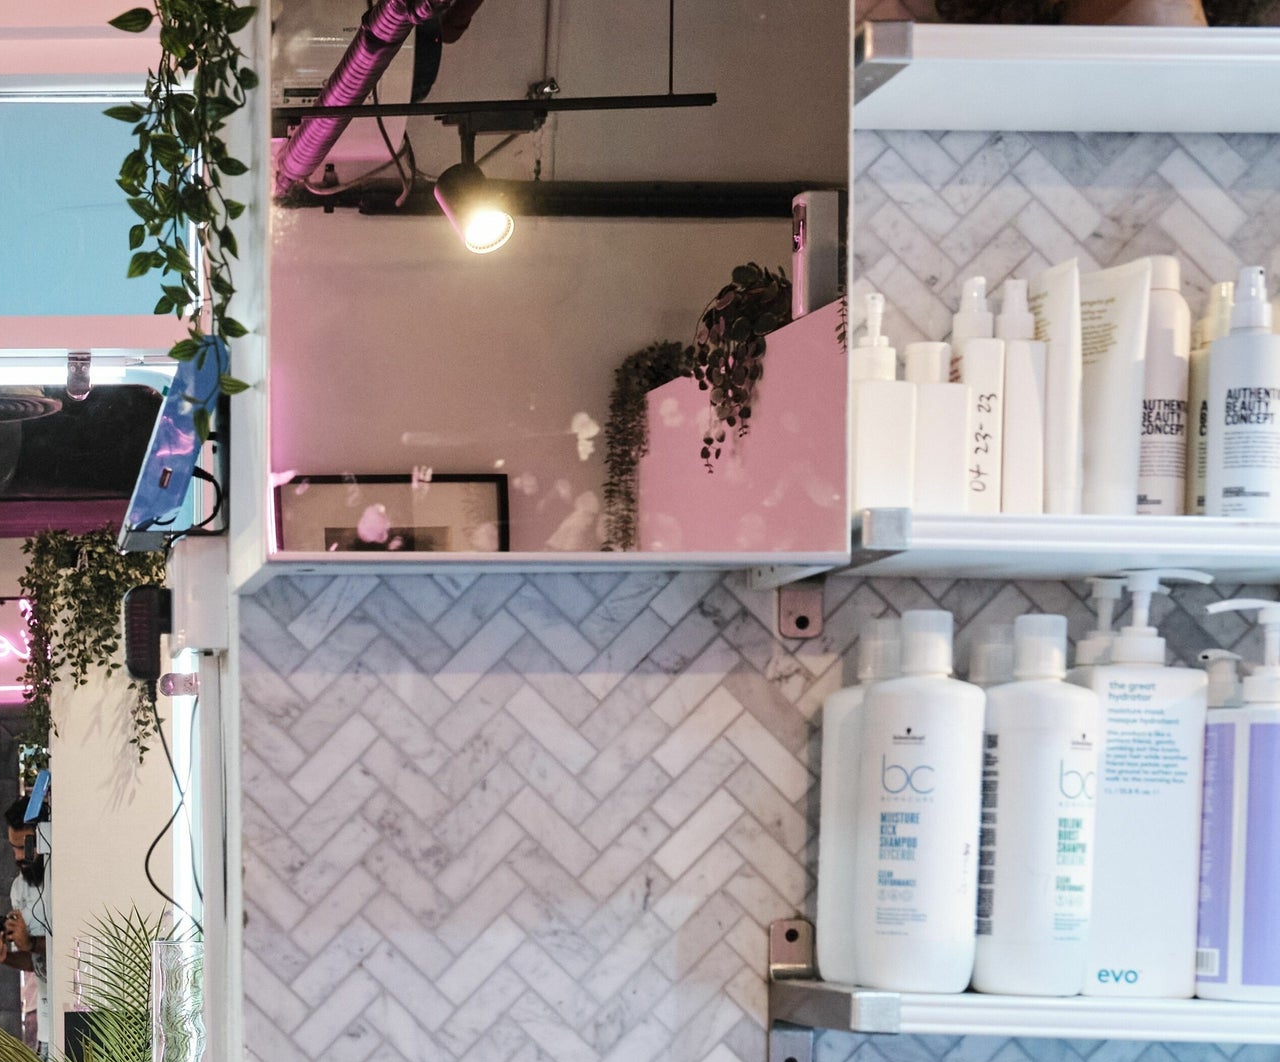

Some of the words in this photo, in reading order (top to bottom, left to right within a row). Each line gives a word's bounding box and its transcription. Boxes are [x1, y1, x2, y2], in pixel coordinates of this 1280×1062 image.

[1226, 400, 1269, 413] BEAUTY
[1225, 413, 1274, 425] CONCEPT
[1109, 682, 1126, 690] the
[1128, 683, 1156, 692] great
[1108, 692, 1152, 702] hydrator
[881, 753, 935, 794] bc
[880, 813, 920, 824] MOISTURE
[880, 824, 897, 835] KICK
[879, 837, 918, 848] SHAMPOO
[1097, 969, 1138, 984] evo
